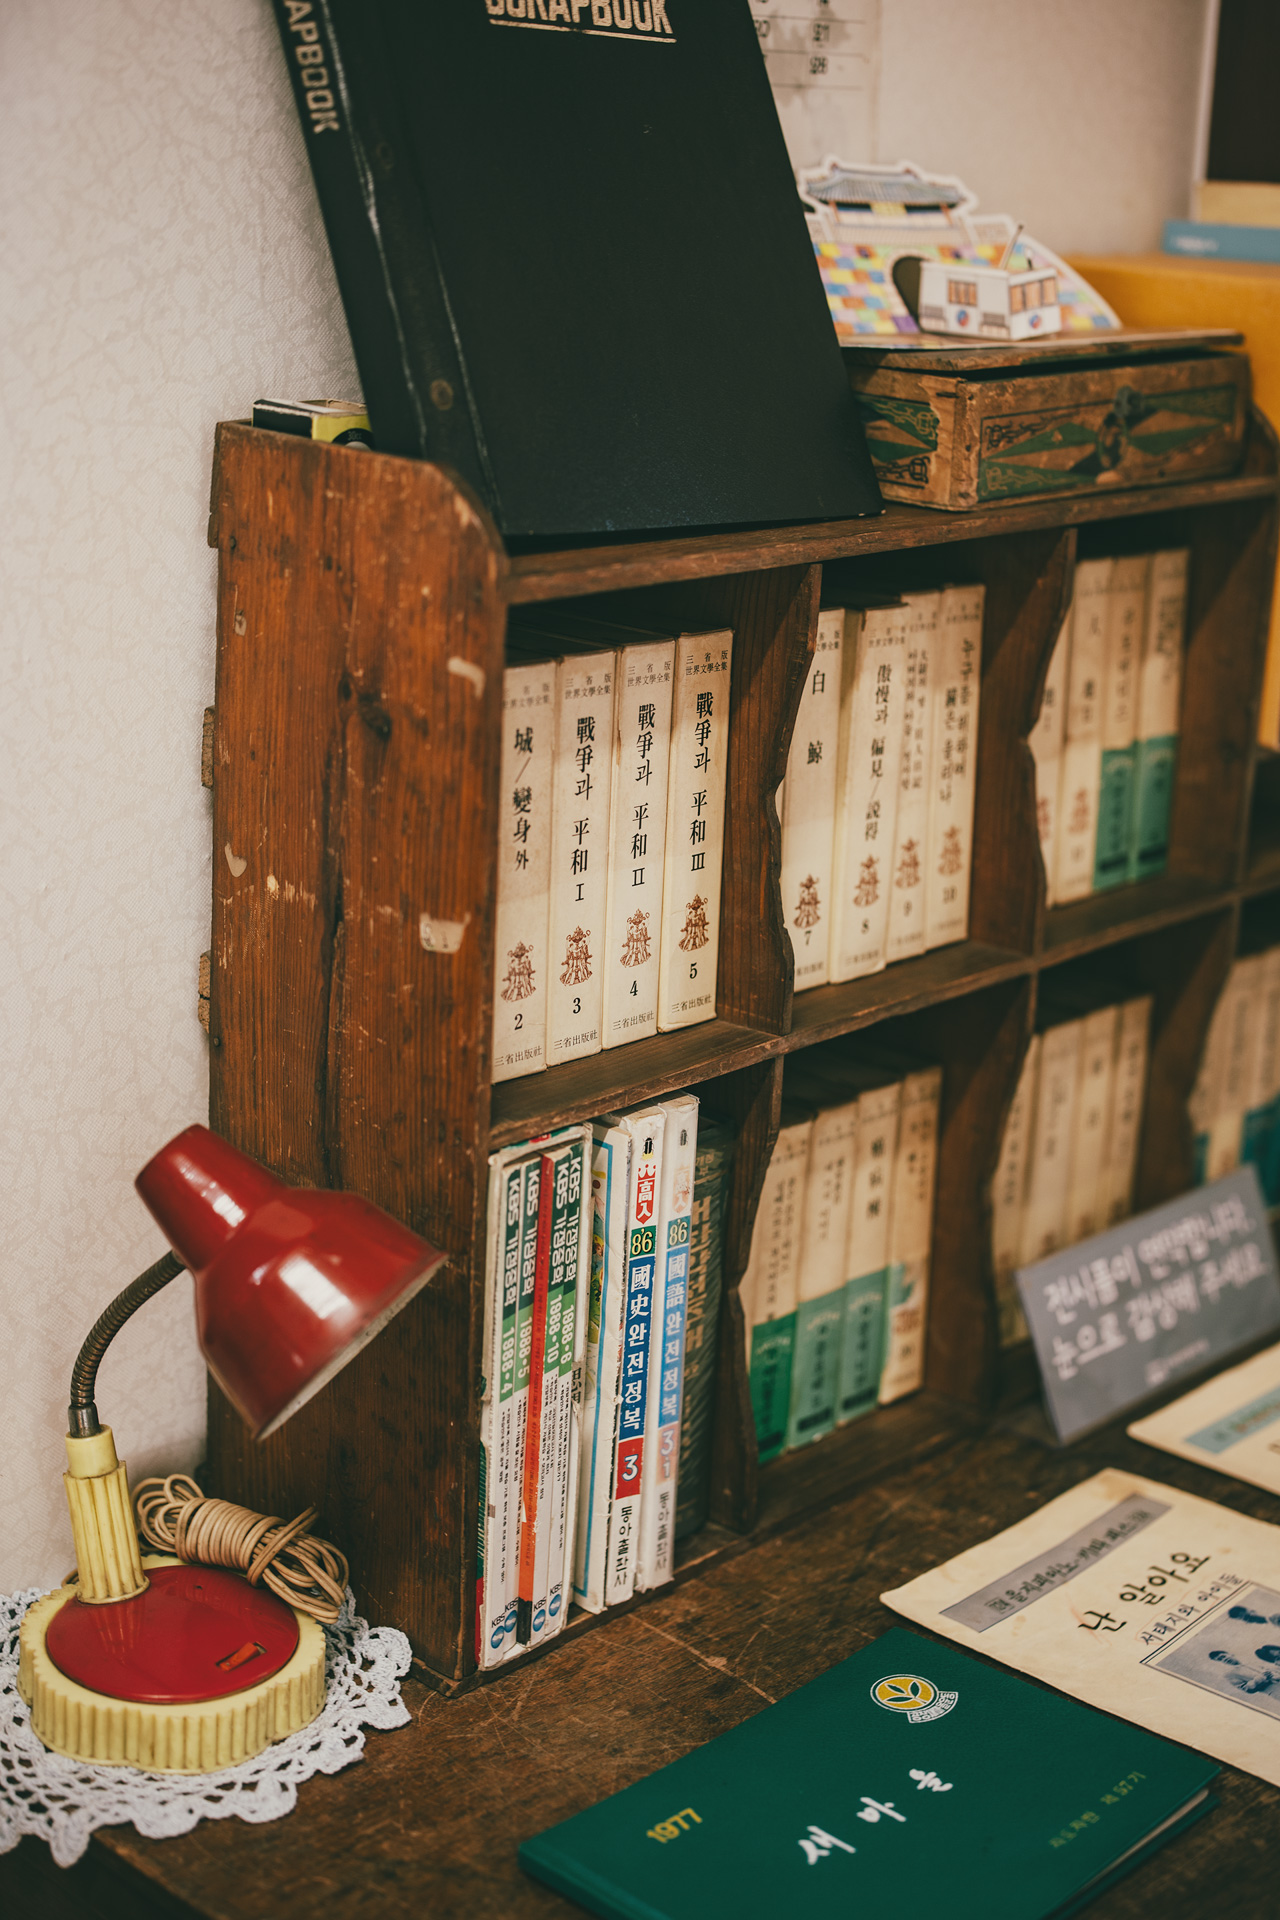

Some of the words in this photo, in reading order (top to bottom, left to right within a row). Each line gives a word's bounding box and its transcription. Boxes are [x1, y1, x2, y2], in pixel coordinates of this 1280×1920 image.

[564, 684, 612, 700] 世界文學全集
[627, 672, 671, 687] 世界文學全集
[685, 661, 728, 676] 世界文學全集
[635, 703, 656, 786] 戰爭과
[693, 691, 714, 774] 戰爭과
[575, 716, 596, 801] 戰爭과
[631, 802, 649, 860] 平和
[689, 789, 708, 846] 平和
[571, 817, 590, 876] 平和
[804, 929, 812, 946] 7
[861, 918, 869, 935] 8
[629, 980, 638, 997] 4
[689, 962, 698, 980] 5
[514, 1013, 523, 1031] 2
[572, 997, 581, 1014] 3
[612, 1010, 655, 1031] 三省出版社
[671, 993, 713, 1013] 三省出版社
[553, 1029, 598, 1050] 三省出版社
[507, 1177, 521, 1226] KBS
[526, 1168, 540, 1217] KBS
[555, 1161, 569, 1210] KBS
[567, 1156, 581, 1204] KBS
[637, 1180, 653, 1219] 高入
[504, 1228, 519, 1308] 가정중학
[522, 1218, 538, 1297] 가정중학
[551, 1212, 567, 1286] 가정중학
[564, 1206, 579, 1283] 가정중학
[629, 1263, 652, 1321] 國史
[666, 1253, 687, 1310] 國語
[623, 1322, 647, 1430] 완전정복
[662, 1311, 683, 1417] 완전정복
[621, 1454, 639, 1481] 3
[504, 1595, 519, 1613] KBS
[533, 1595, 547, 1612] KBS
[549, 1580, 563, 1596] KBS
[1078, 1609, 1128, 1632] 난
[1118, 1551, 1211, 1606] 알아요
[1140, 1603, 1201, 1646] 서태지와
[1197, 1571, 1243, 1605] 아이들
[491, 1610, 506, 1628] KBS
[646, 1807, 703, 1844] 1977
